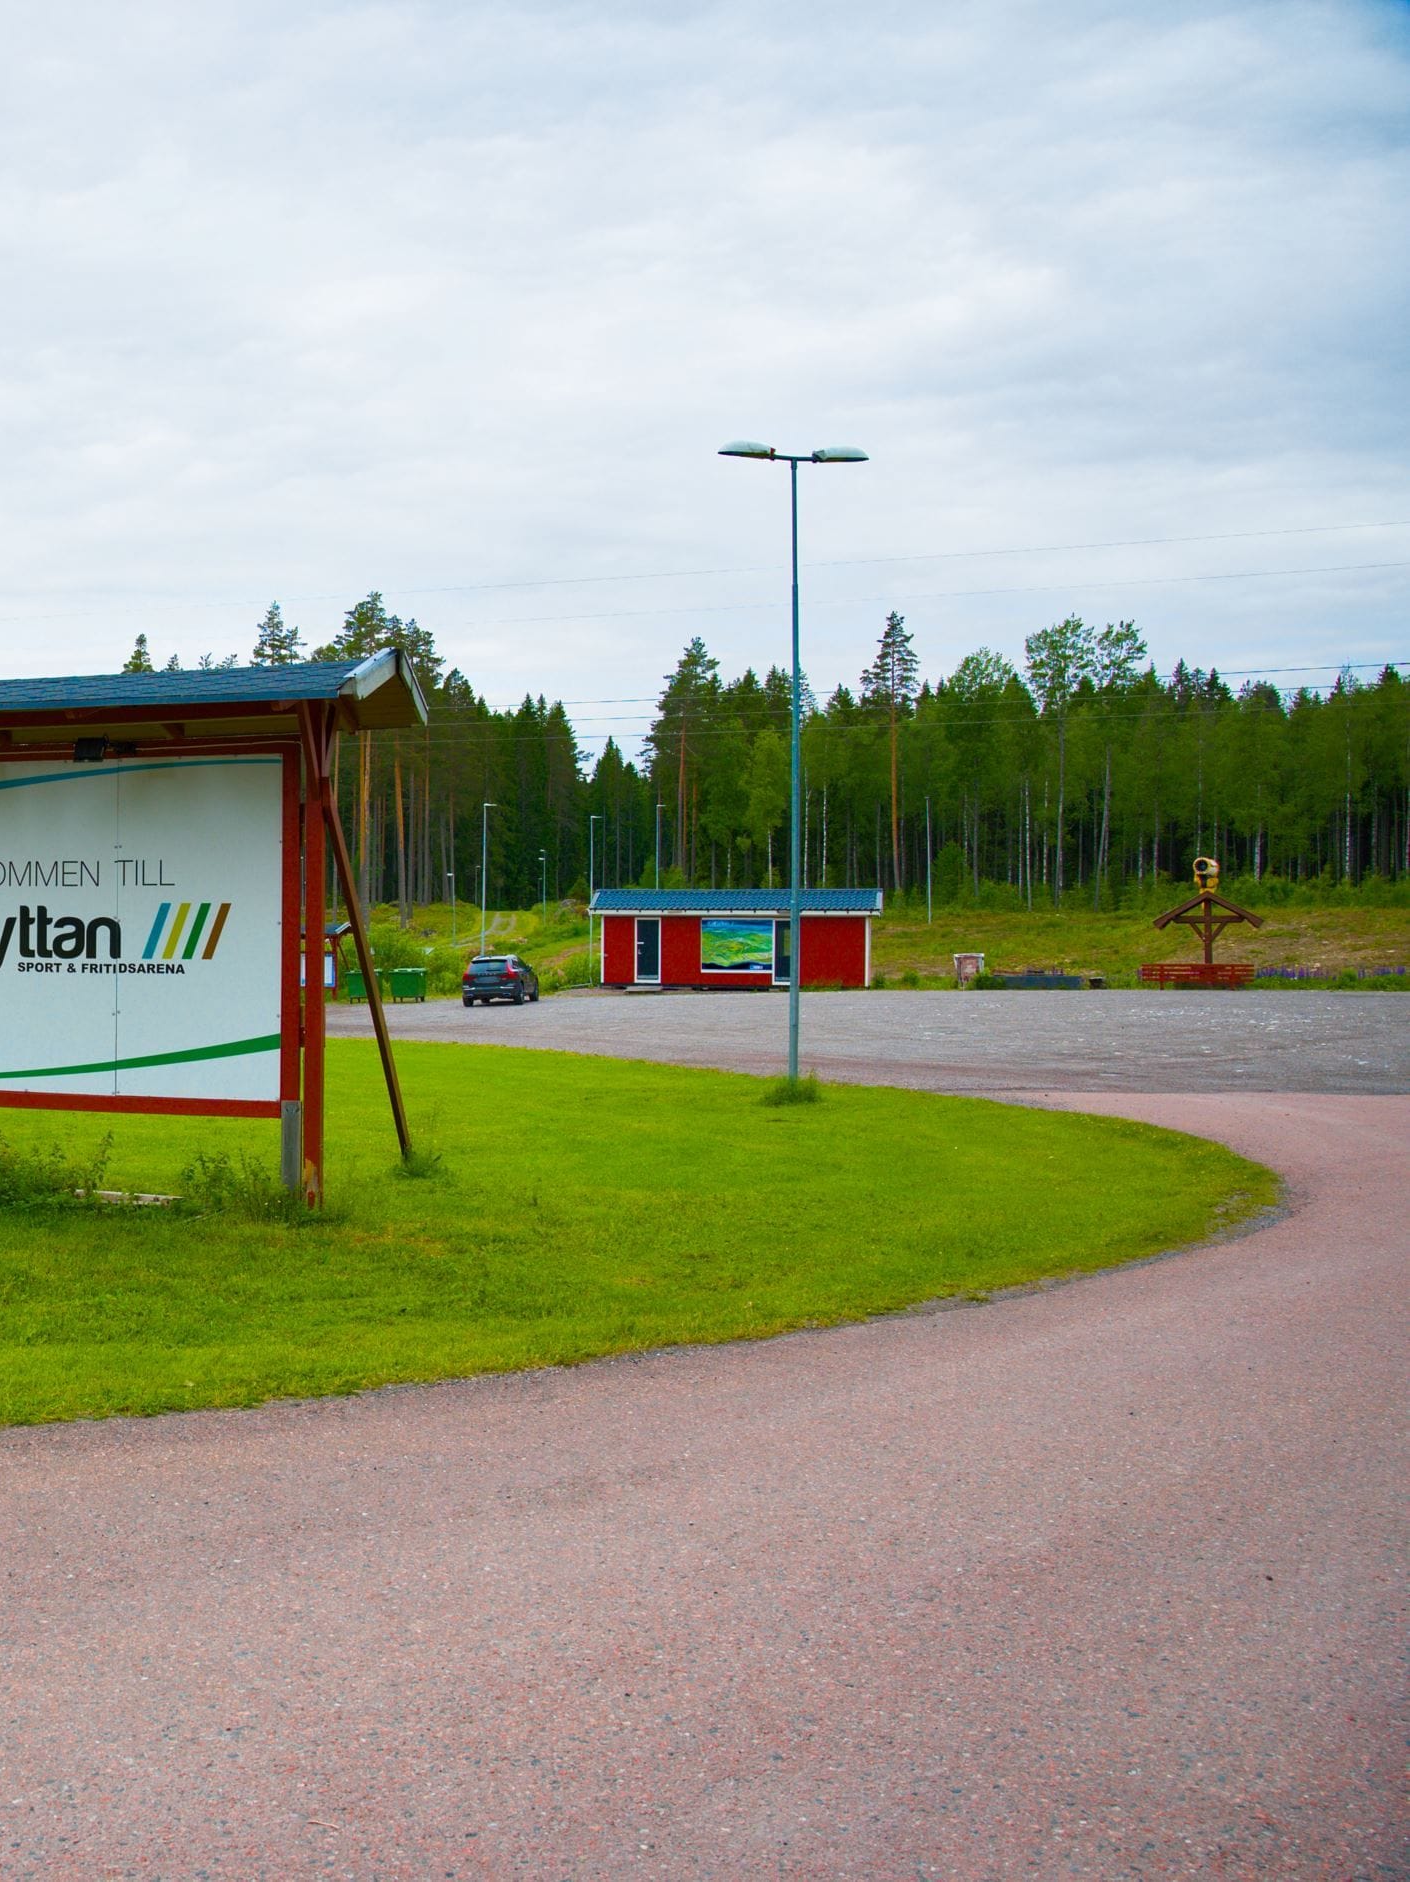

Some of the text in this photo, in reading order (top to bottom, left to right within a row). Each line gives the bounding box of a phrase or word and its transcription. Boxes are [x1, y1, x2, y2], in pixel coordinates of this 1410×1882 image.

[115, 859, 175, 886] TILL
[18, 962, 185, 974] SPORT & FRITIDSARENA
